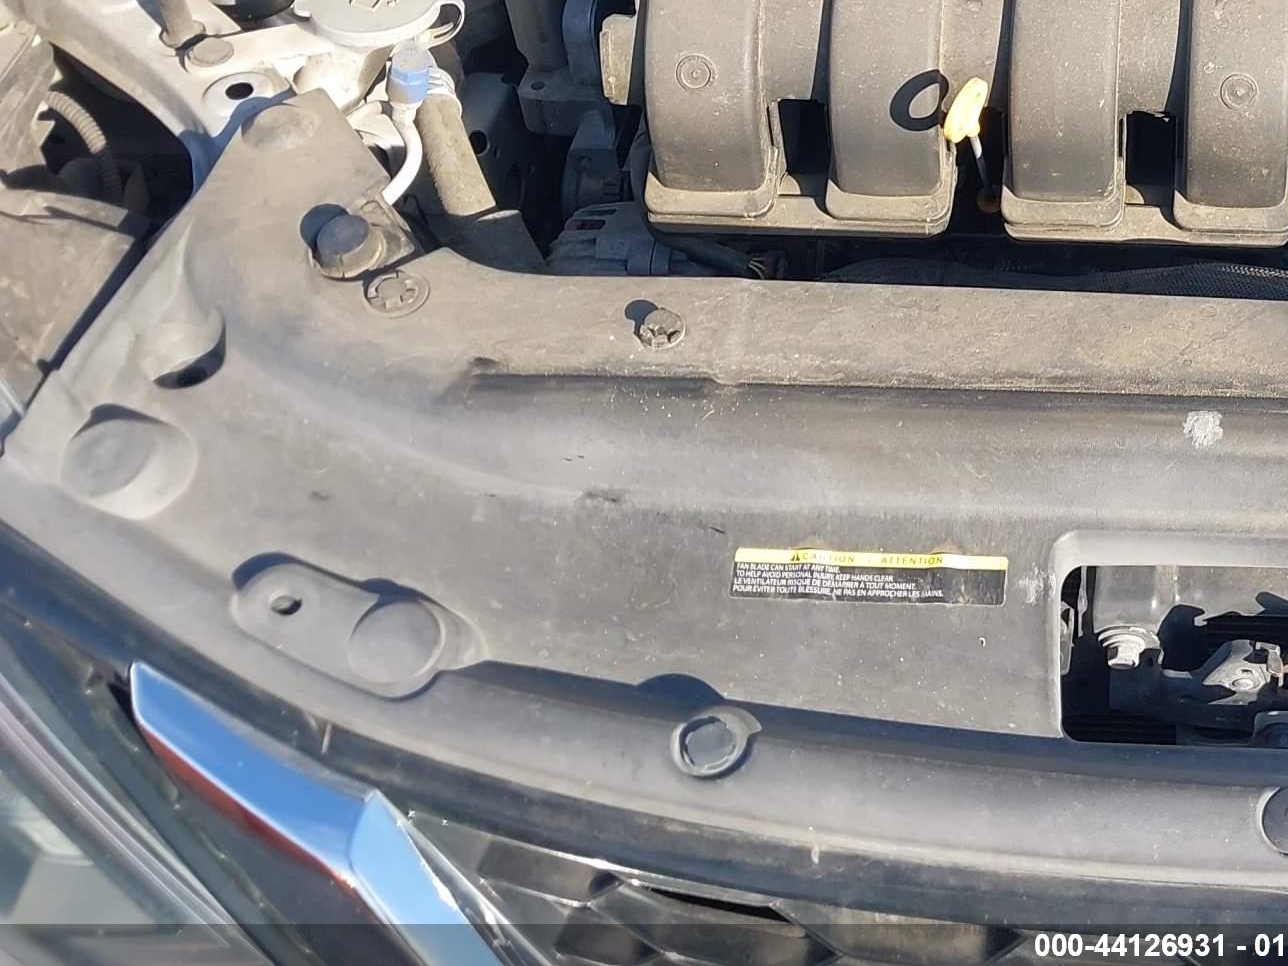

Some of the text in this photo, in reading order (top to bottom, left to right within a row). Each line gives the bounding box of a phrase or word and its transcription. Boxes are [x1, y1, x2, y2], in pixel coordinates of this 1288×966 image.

[881, 556, 942, 565] ATTENTION
[750, 563, 770, 571] BLADE
[785, 564, 802, 572] START
[802, 564, 811, 572] AT
[811, 564, 824, 573] ANY
[746, 570, 761, 578] HELP
[762, 571, 781, 579] AVOID
[782, 571, 812, 579] PERSONAL
[835, 573, 851, 581] KEEP
[851, 574, 873, 582] HANDS
[743, 578, 787, 586] VENTILATEUR
[812, 579, 821, 587] DE
[866, 582, 884, 590] TOUT
[776, 586, 797, 594] TOUTE
[833, 587, 842, 596] NE
[843, 588, 856, 596] PAS
[857, 588, 867, 596] EN
[867, 589, 908, 598] APPROCHER
[908, 590, 920, 598] LES
